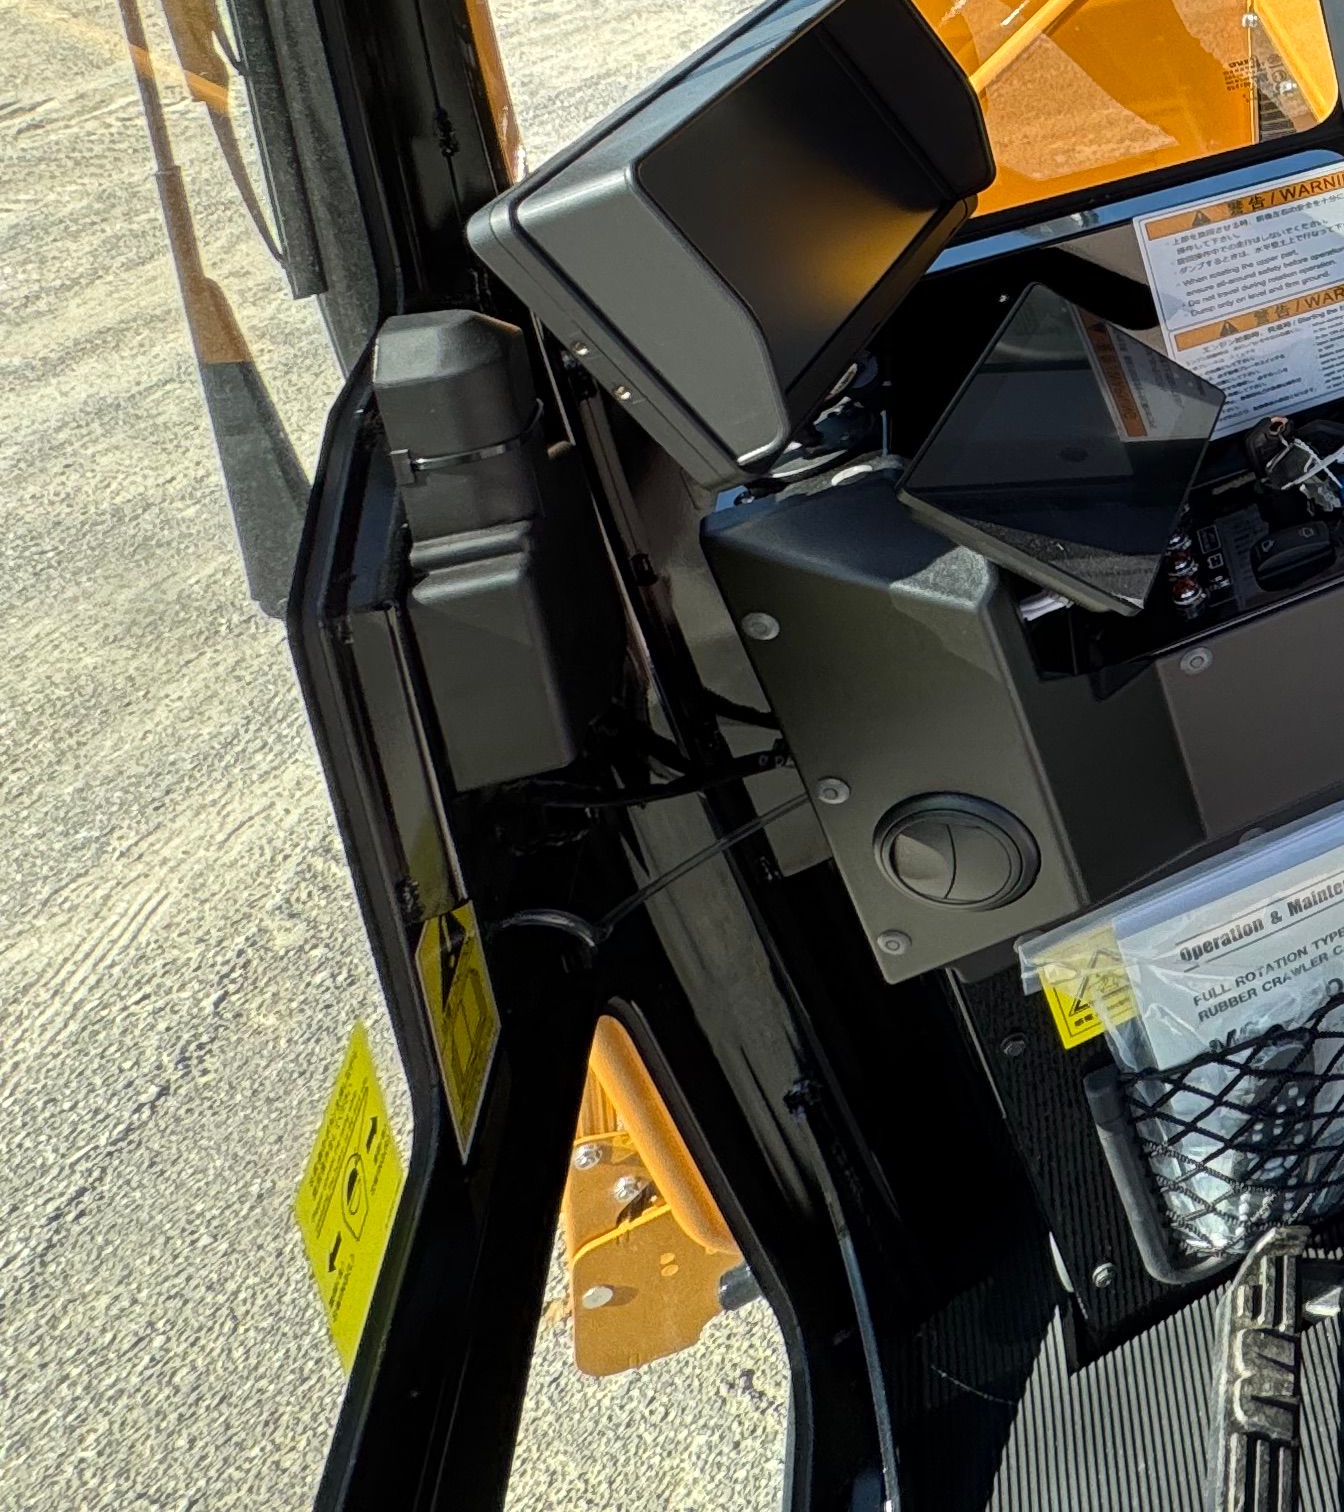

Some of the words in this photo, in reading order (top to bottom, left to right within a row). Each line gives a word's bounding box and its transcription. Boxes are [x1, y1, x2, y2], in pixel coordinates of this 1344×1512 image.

[1182, 274, 1208, 287] When
[1208, 265, 1240, 279] rotating
[1241, 261, 1254, 270] the
[1255, 254, 1279, 266] upper
[1185, 282, 1215, 296] ensure
[1257, 263, 1282, 276] safety
[1283, 256, 1309, 269] before
[1187, 297, 1200, 306] Do
[1201, 292, 1216, 302] not
[1216, 286, 1239, 298] travel
[1240, 278, 1266, 291] during
[1267, 269, 1297, 284] rotation
[1189, 303, 1215, 317] Dump
[1216, 298, 1234, 309] only
[1234, 294, 1246, 304] on
[1247, 288, 1267, 300] level
[1268, 284, 1283, 294] and
[1284, 279, 1300, 290] firm
[1325, 306, 1338, 315] the
[1179, 917, 1264, 964] Operation
[1270, 910, 1284, 926] &
[1193, 983, 1232, 1008] FULL
[1235, 946, 1309, 989] ROTATION
[1197, 990, 1260, 1024] RUBBER
[1262, 953, 1330, 993] CRAWLER
